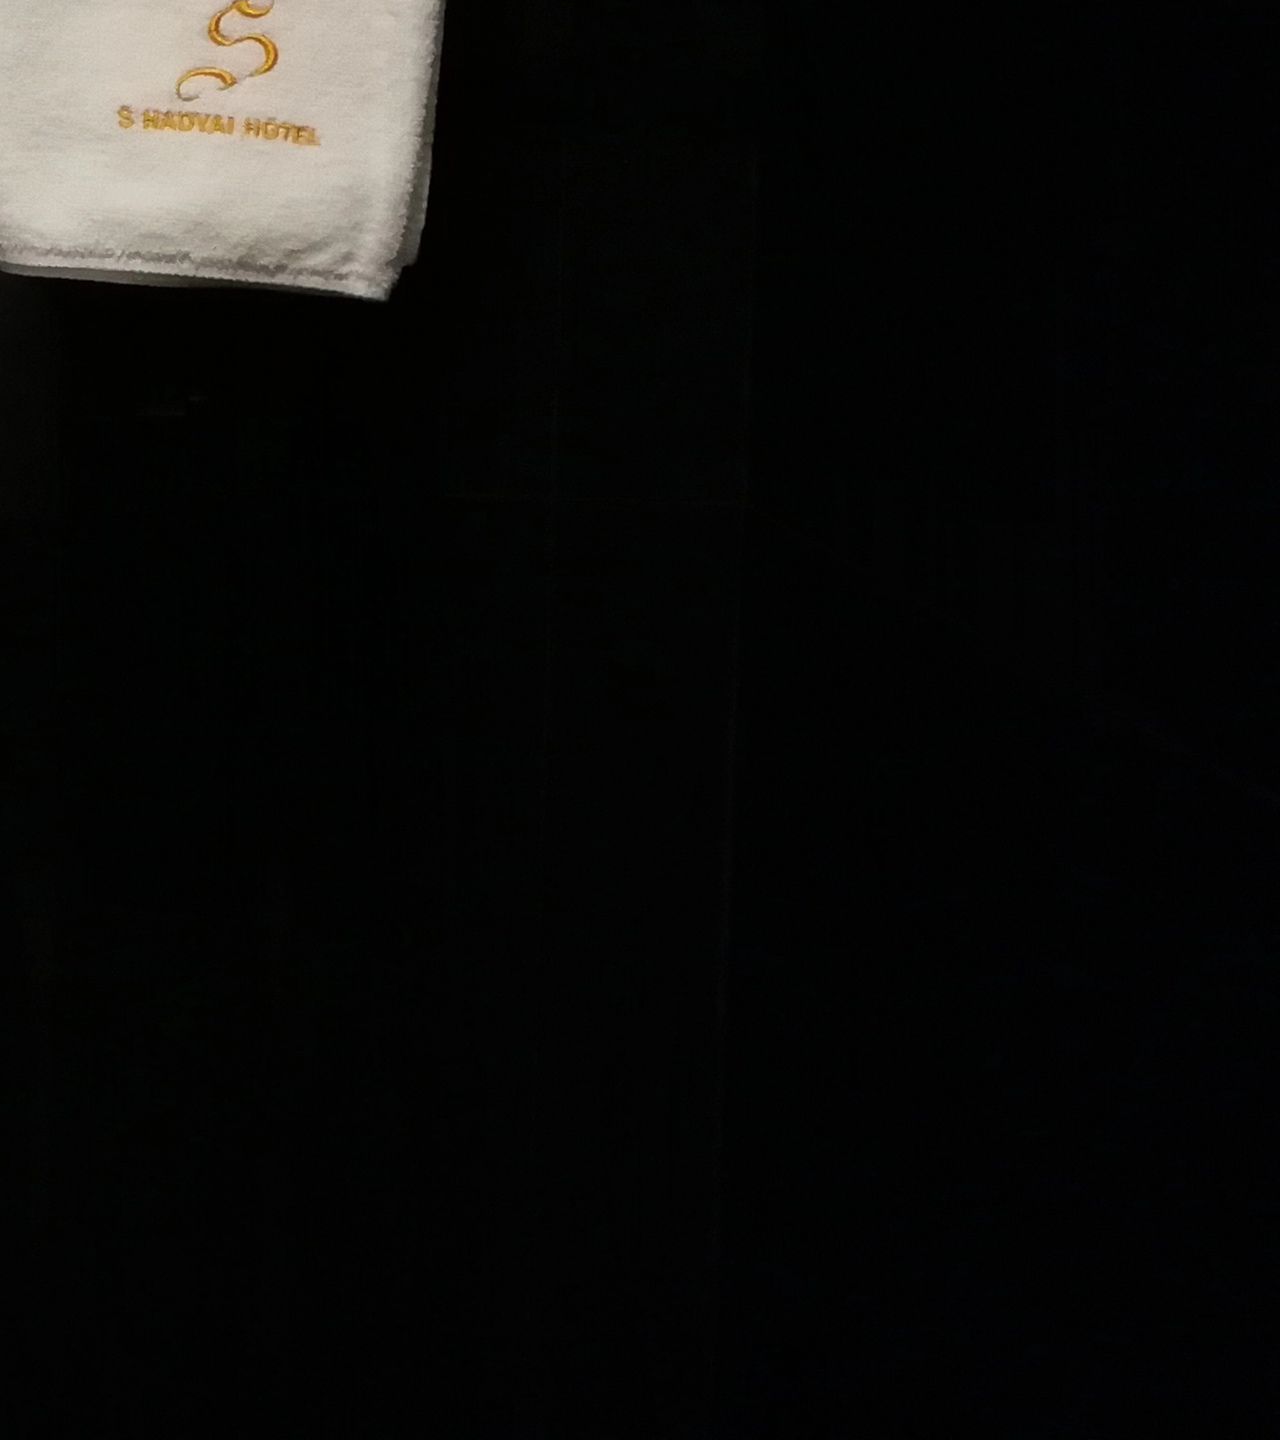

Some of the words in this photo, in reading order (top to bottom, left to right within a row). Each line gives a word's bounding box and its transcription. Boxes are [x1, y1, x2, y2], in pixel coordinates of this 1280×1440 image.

[117, 105, 134, 129] S
[142, 108, 235, 135] HADYAI
[243, 117, 321, 146] HOTEL
